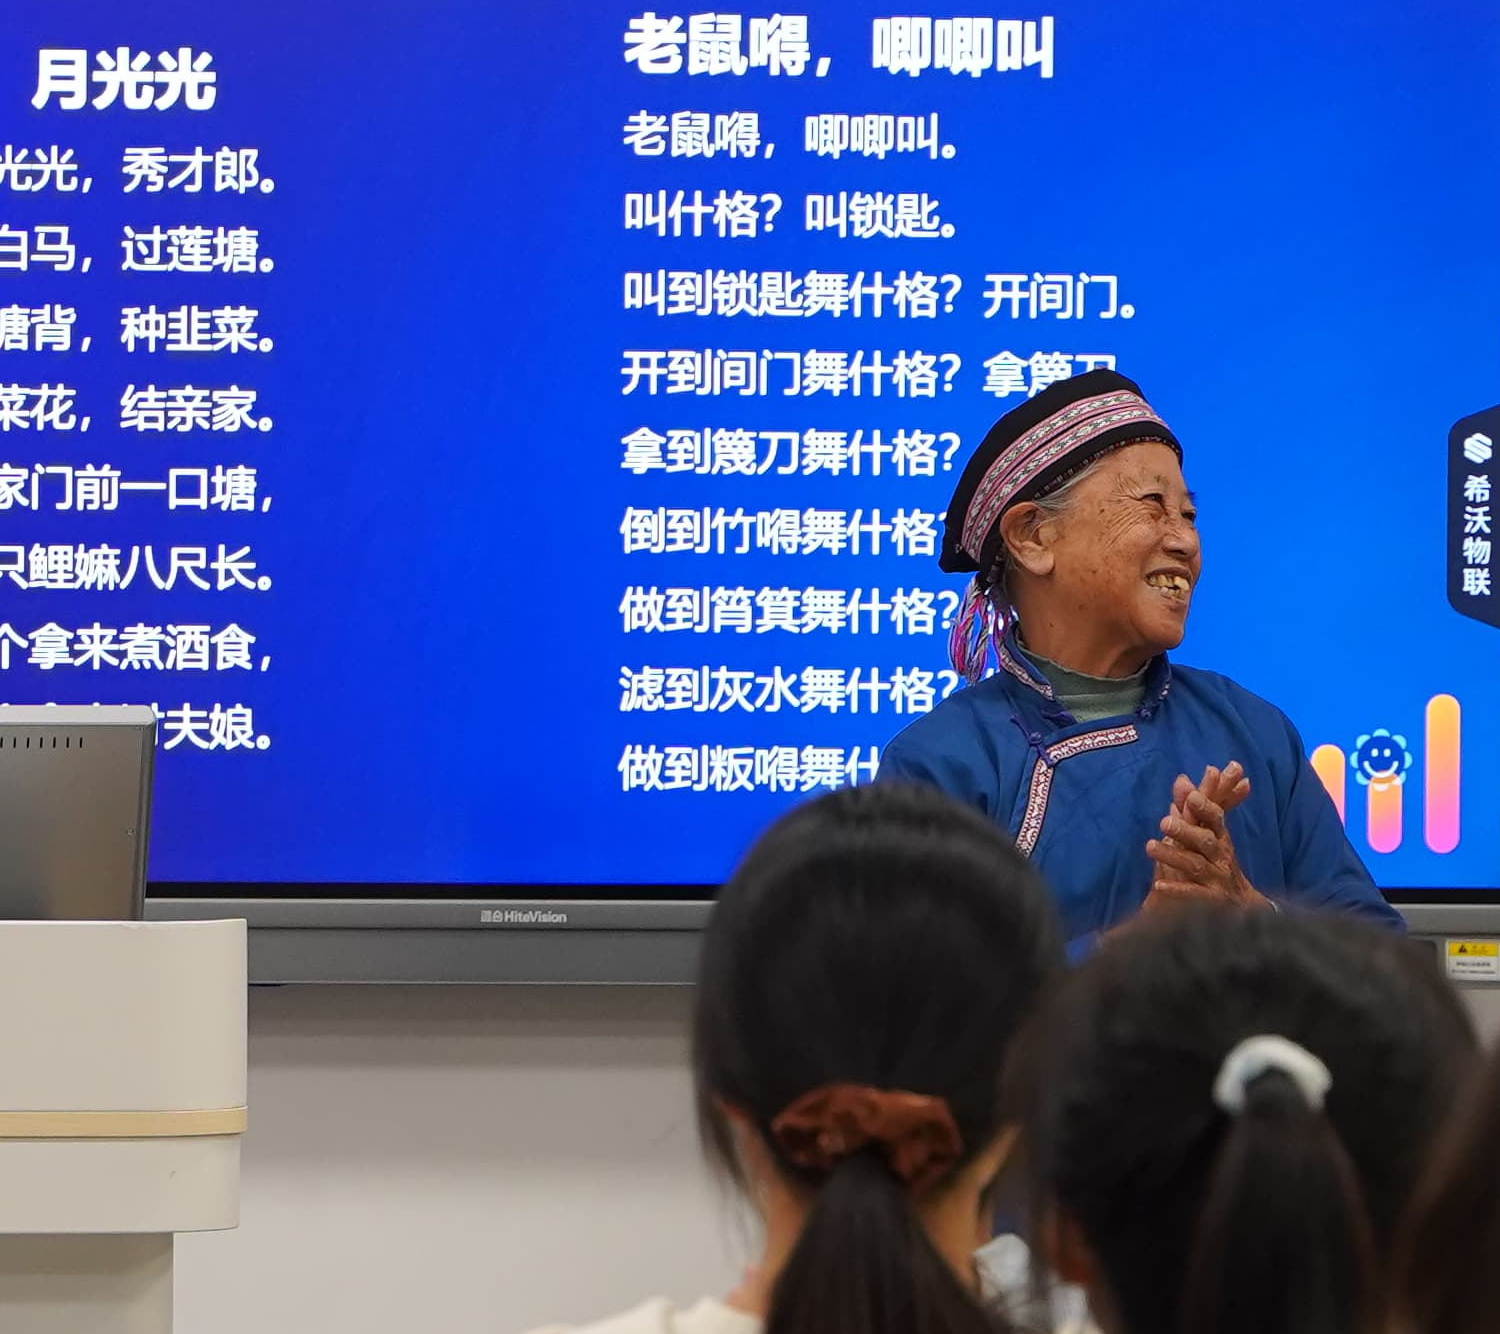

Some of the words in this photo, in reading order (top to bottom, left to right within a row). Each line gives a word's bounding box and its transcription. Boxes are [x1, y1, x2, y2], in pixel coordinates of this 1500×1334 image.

[31, 46, 217, 111] 月光光
[624, 189, 955, 239] 叫什格？叫锁匙。
[624, 269, 1135, 319] 叫到锁匙舞什格？开间门。
[620, 349, 1117, 398] 开到间门舞什格？拿篾
[1462, 474, 1492, 596] 希沃物联
